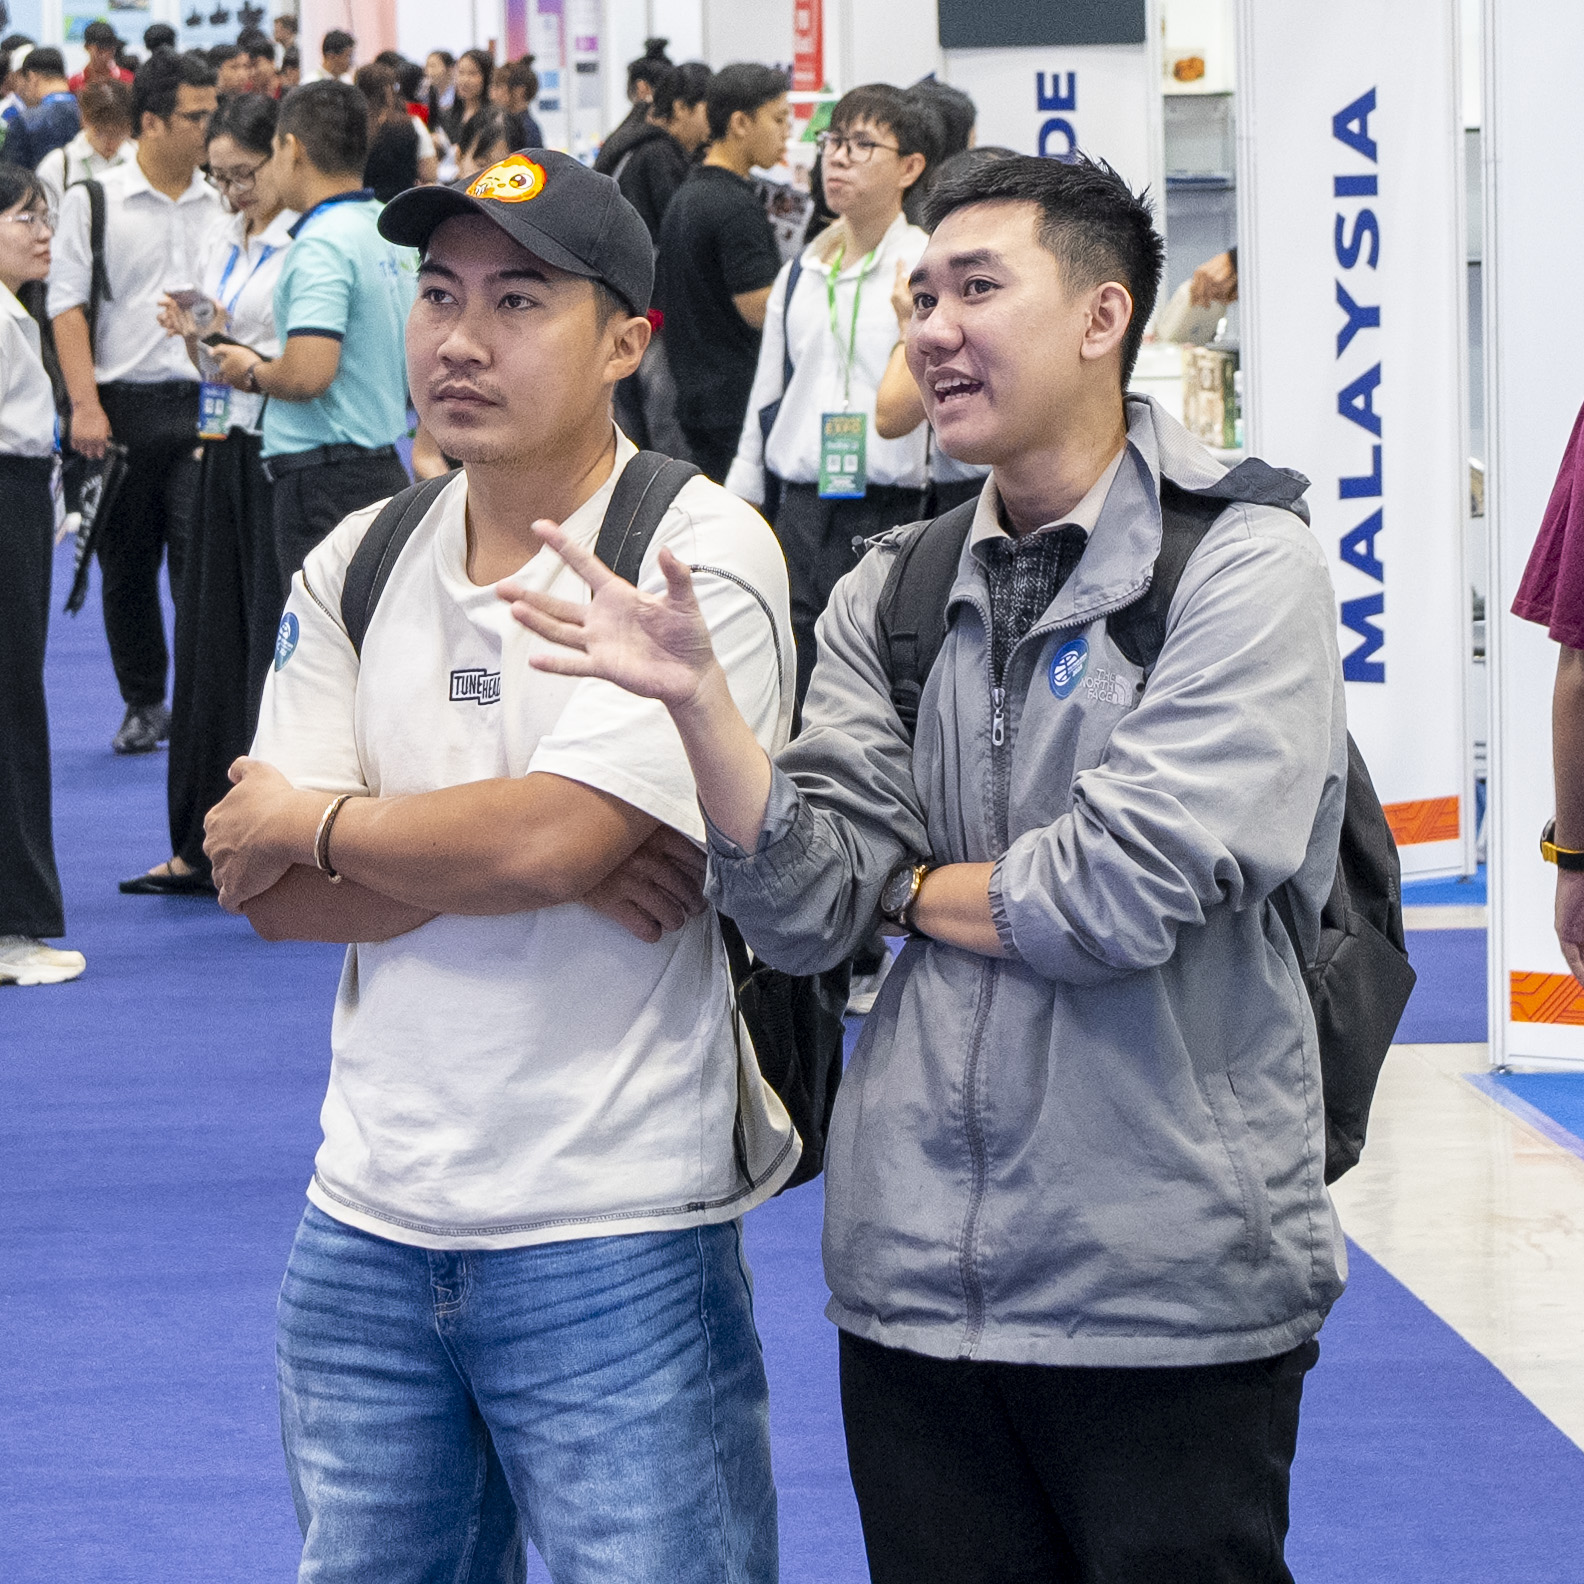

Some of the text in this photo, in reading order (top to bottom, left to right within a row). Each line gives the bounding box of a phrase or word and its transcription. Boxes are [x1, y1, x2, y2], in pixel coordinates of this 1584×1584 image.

[1333, 87, 1385, 684] MALAYSIA
[1096, 667, 1116, 681] THE
[454, 674, 483, 696] TUNE
[1080, 676, 1117, 693] NORTH
[1087, 688, 1113, 703] FACE
